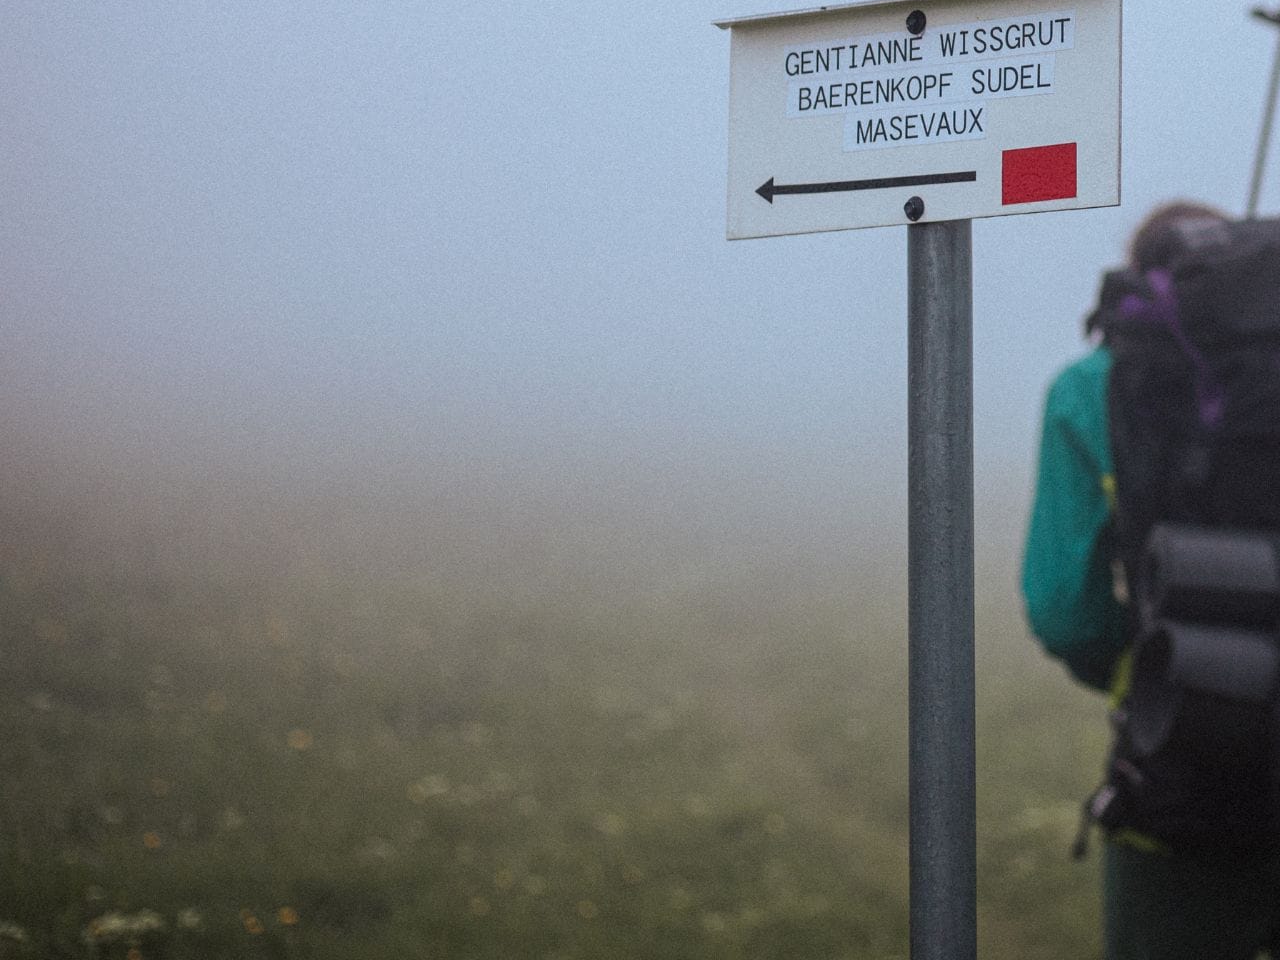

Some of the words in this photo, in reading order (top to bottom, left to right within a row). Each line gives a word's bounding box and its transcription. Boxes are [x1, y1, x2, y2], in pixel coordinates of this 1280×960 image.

[785, 36, 923, 76] GENTIANNE
[940, 18, 1071, 57] WISSGRUT
[798, 72, 953, 111] BAERENKOPF
[971, 63, 1051, 94] SUDEL
[856, 107, 983, 144] MASEVAUX
